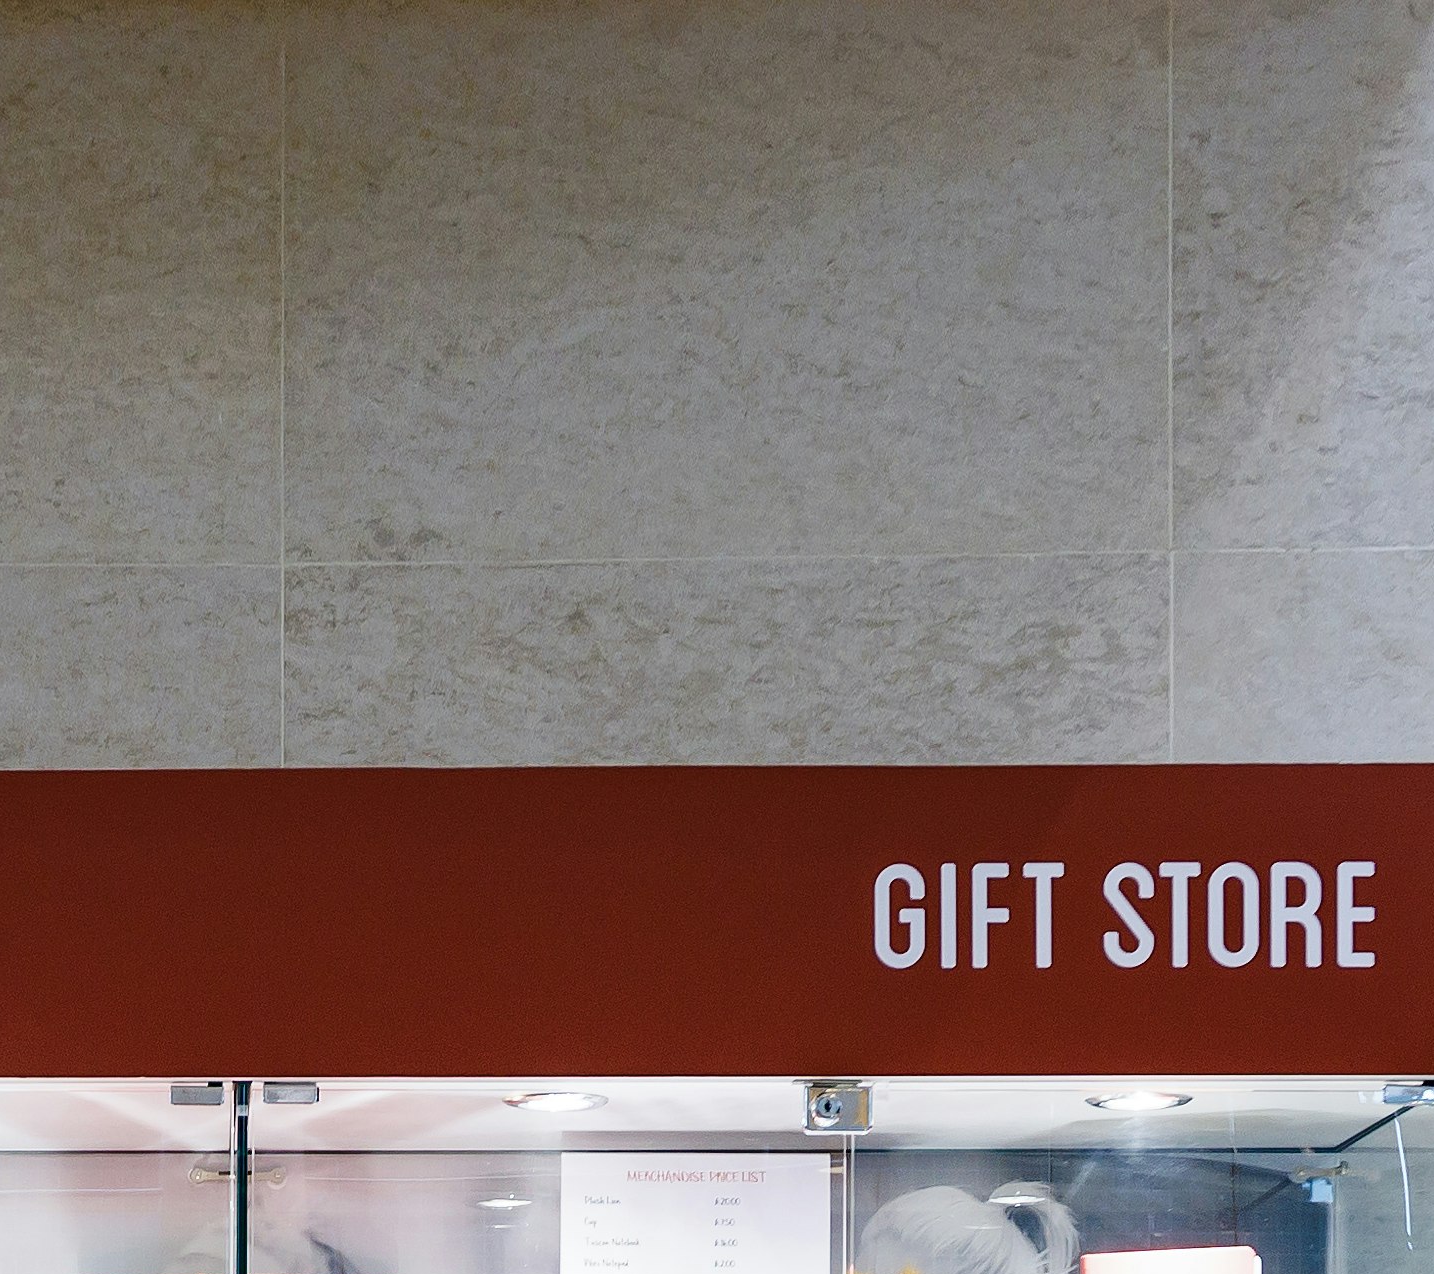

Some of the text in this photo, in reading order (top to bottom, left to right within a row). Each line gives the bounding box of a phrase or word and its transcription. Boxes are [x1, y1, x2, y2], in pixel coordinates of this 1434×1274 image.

[873, 861, 1377, 969] GIFT STORE
[627, 1170, 766, 1183] MERCHANDISE PRICE LIST
